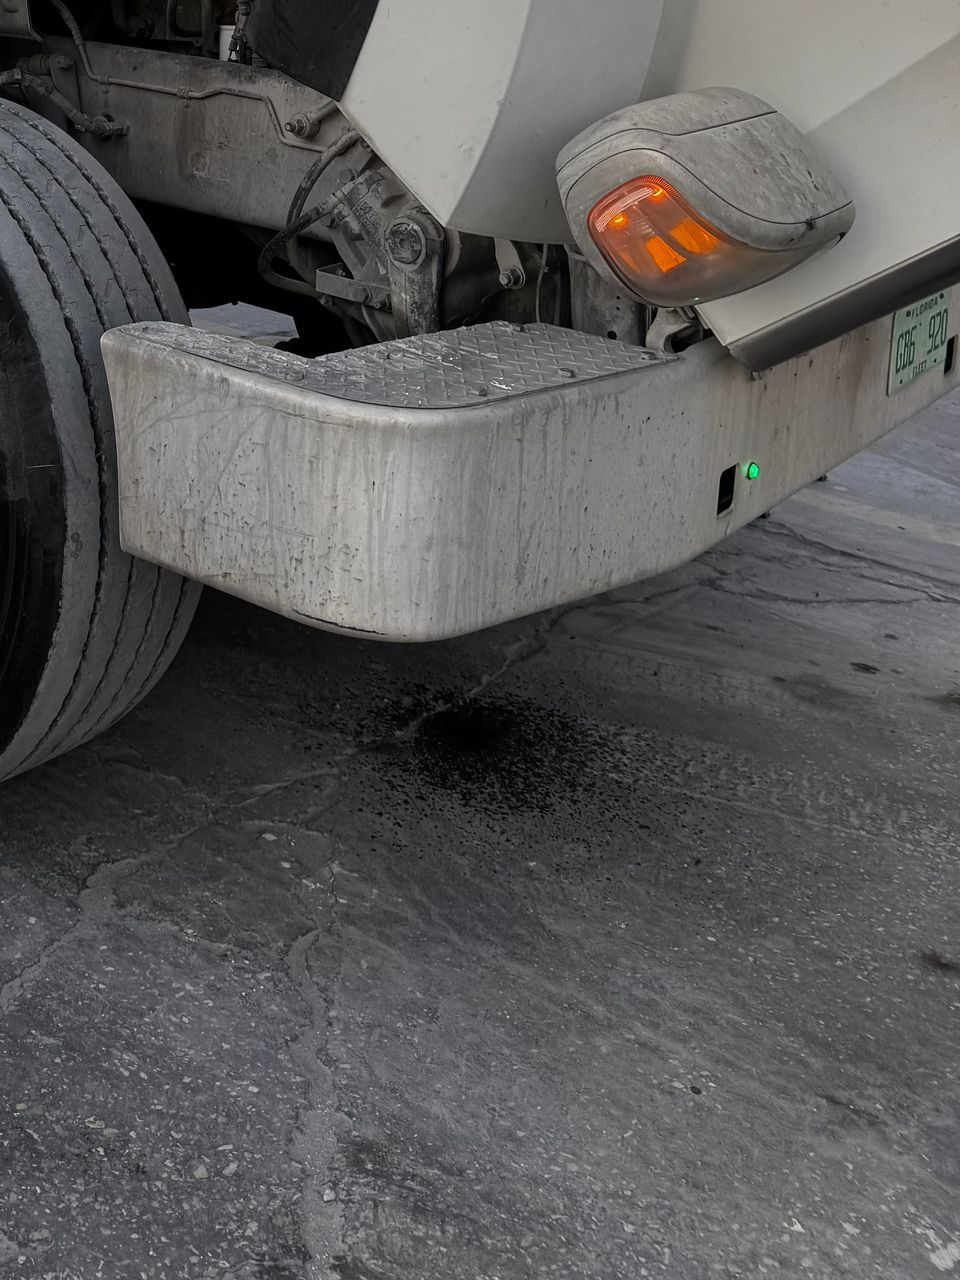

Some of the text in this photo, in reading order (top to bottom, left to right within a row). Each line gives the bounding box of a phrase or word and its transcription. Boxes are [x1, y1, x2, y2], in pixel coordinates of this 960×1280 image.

[911, 296, 938, 319] FLORIDA
[895, 307, 948, 374] GB6 920
[912, 360, 927, 377] FLEET
